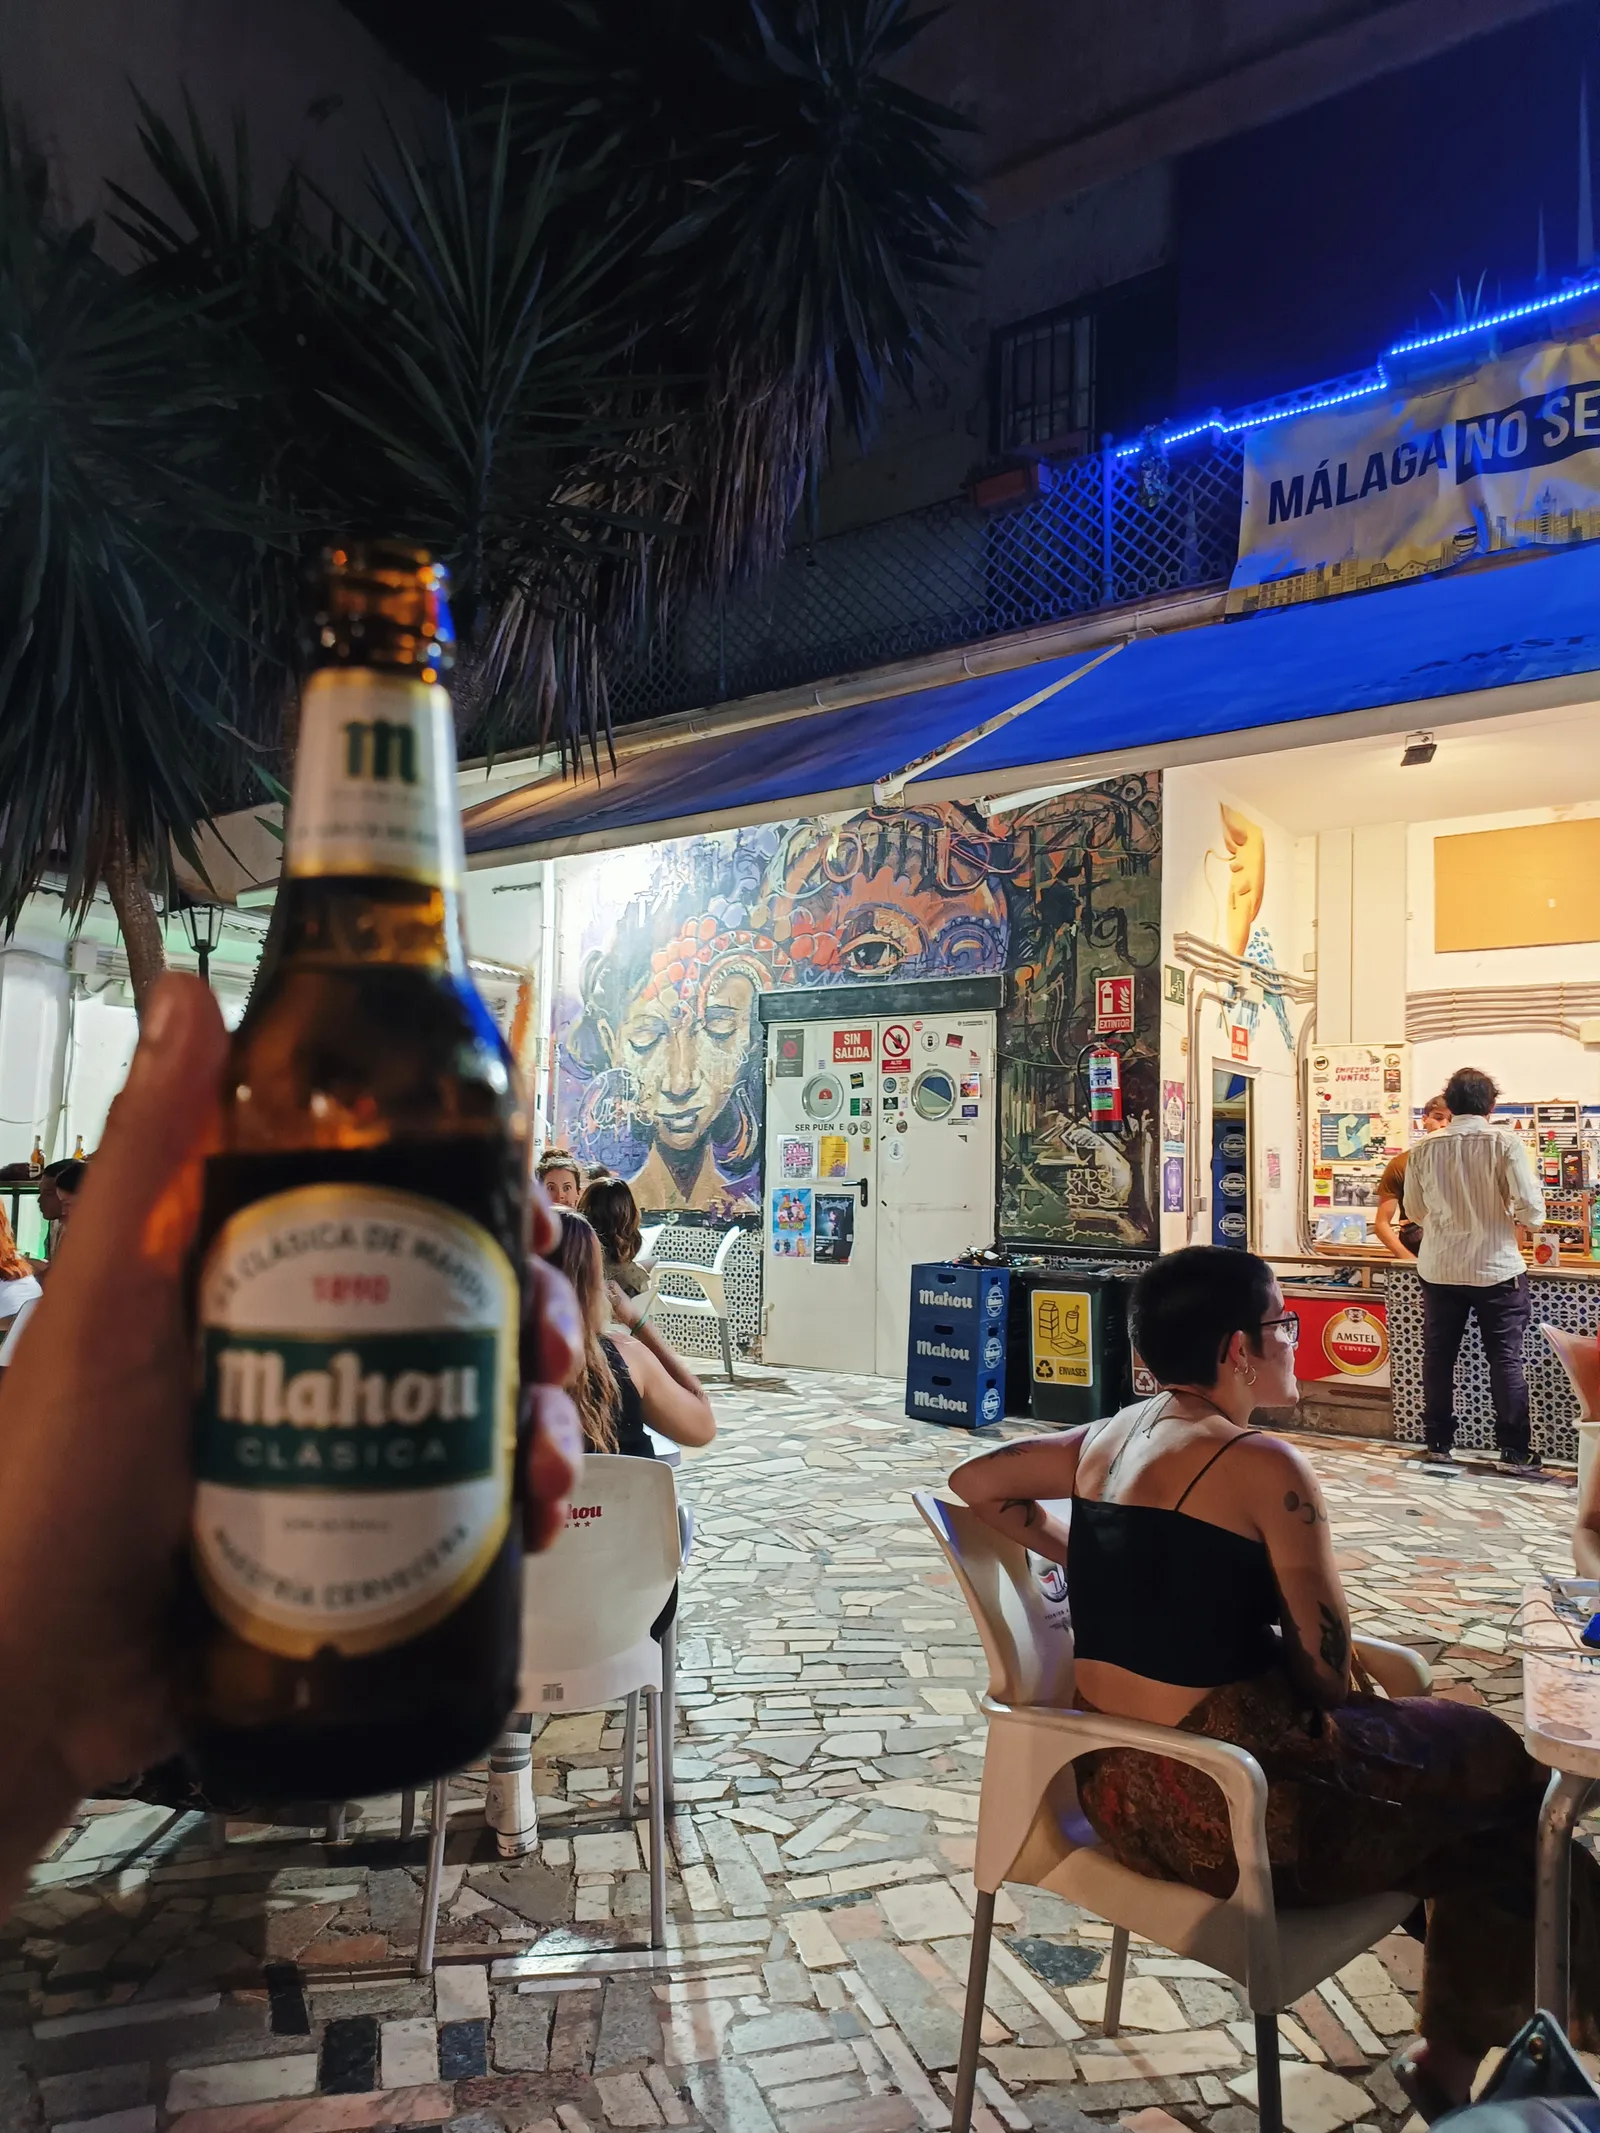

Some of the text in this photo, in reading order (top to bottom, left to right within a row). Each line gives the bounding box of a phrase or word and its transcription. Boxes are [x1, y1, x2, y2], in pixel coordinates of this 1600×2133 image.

[1268, 428, 1448, 525] MÁLAGA
[1463, 410, 1528, 465] NO
[1099, 1018, 1131, 1029] EXTINTOR
[844, 1033, 861, 1045] SIN
[835, 1046, 870, 1059] SALIDA
[919, 1289, 973, 1309] Mahou
[1336, 1332, 1376, 1344] AMSTEL
[916, 1340, 971, 1361] Mahou
[1339, 1344, 1373, 1353] CERVEZA
[1058, 1365, 1088, 1378] ENVASES
[217, 1350, 480, 1429] Mahou
[913, 1391, 969, 1413] Mahou
